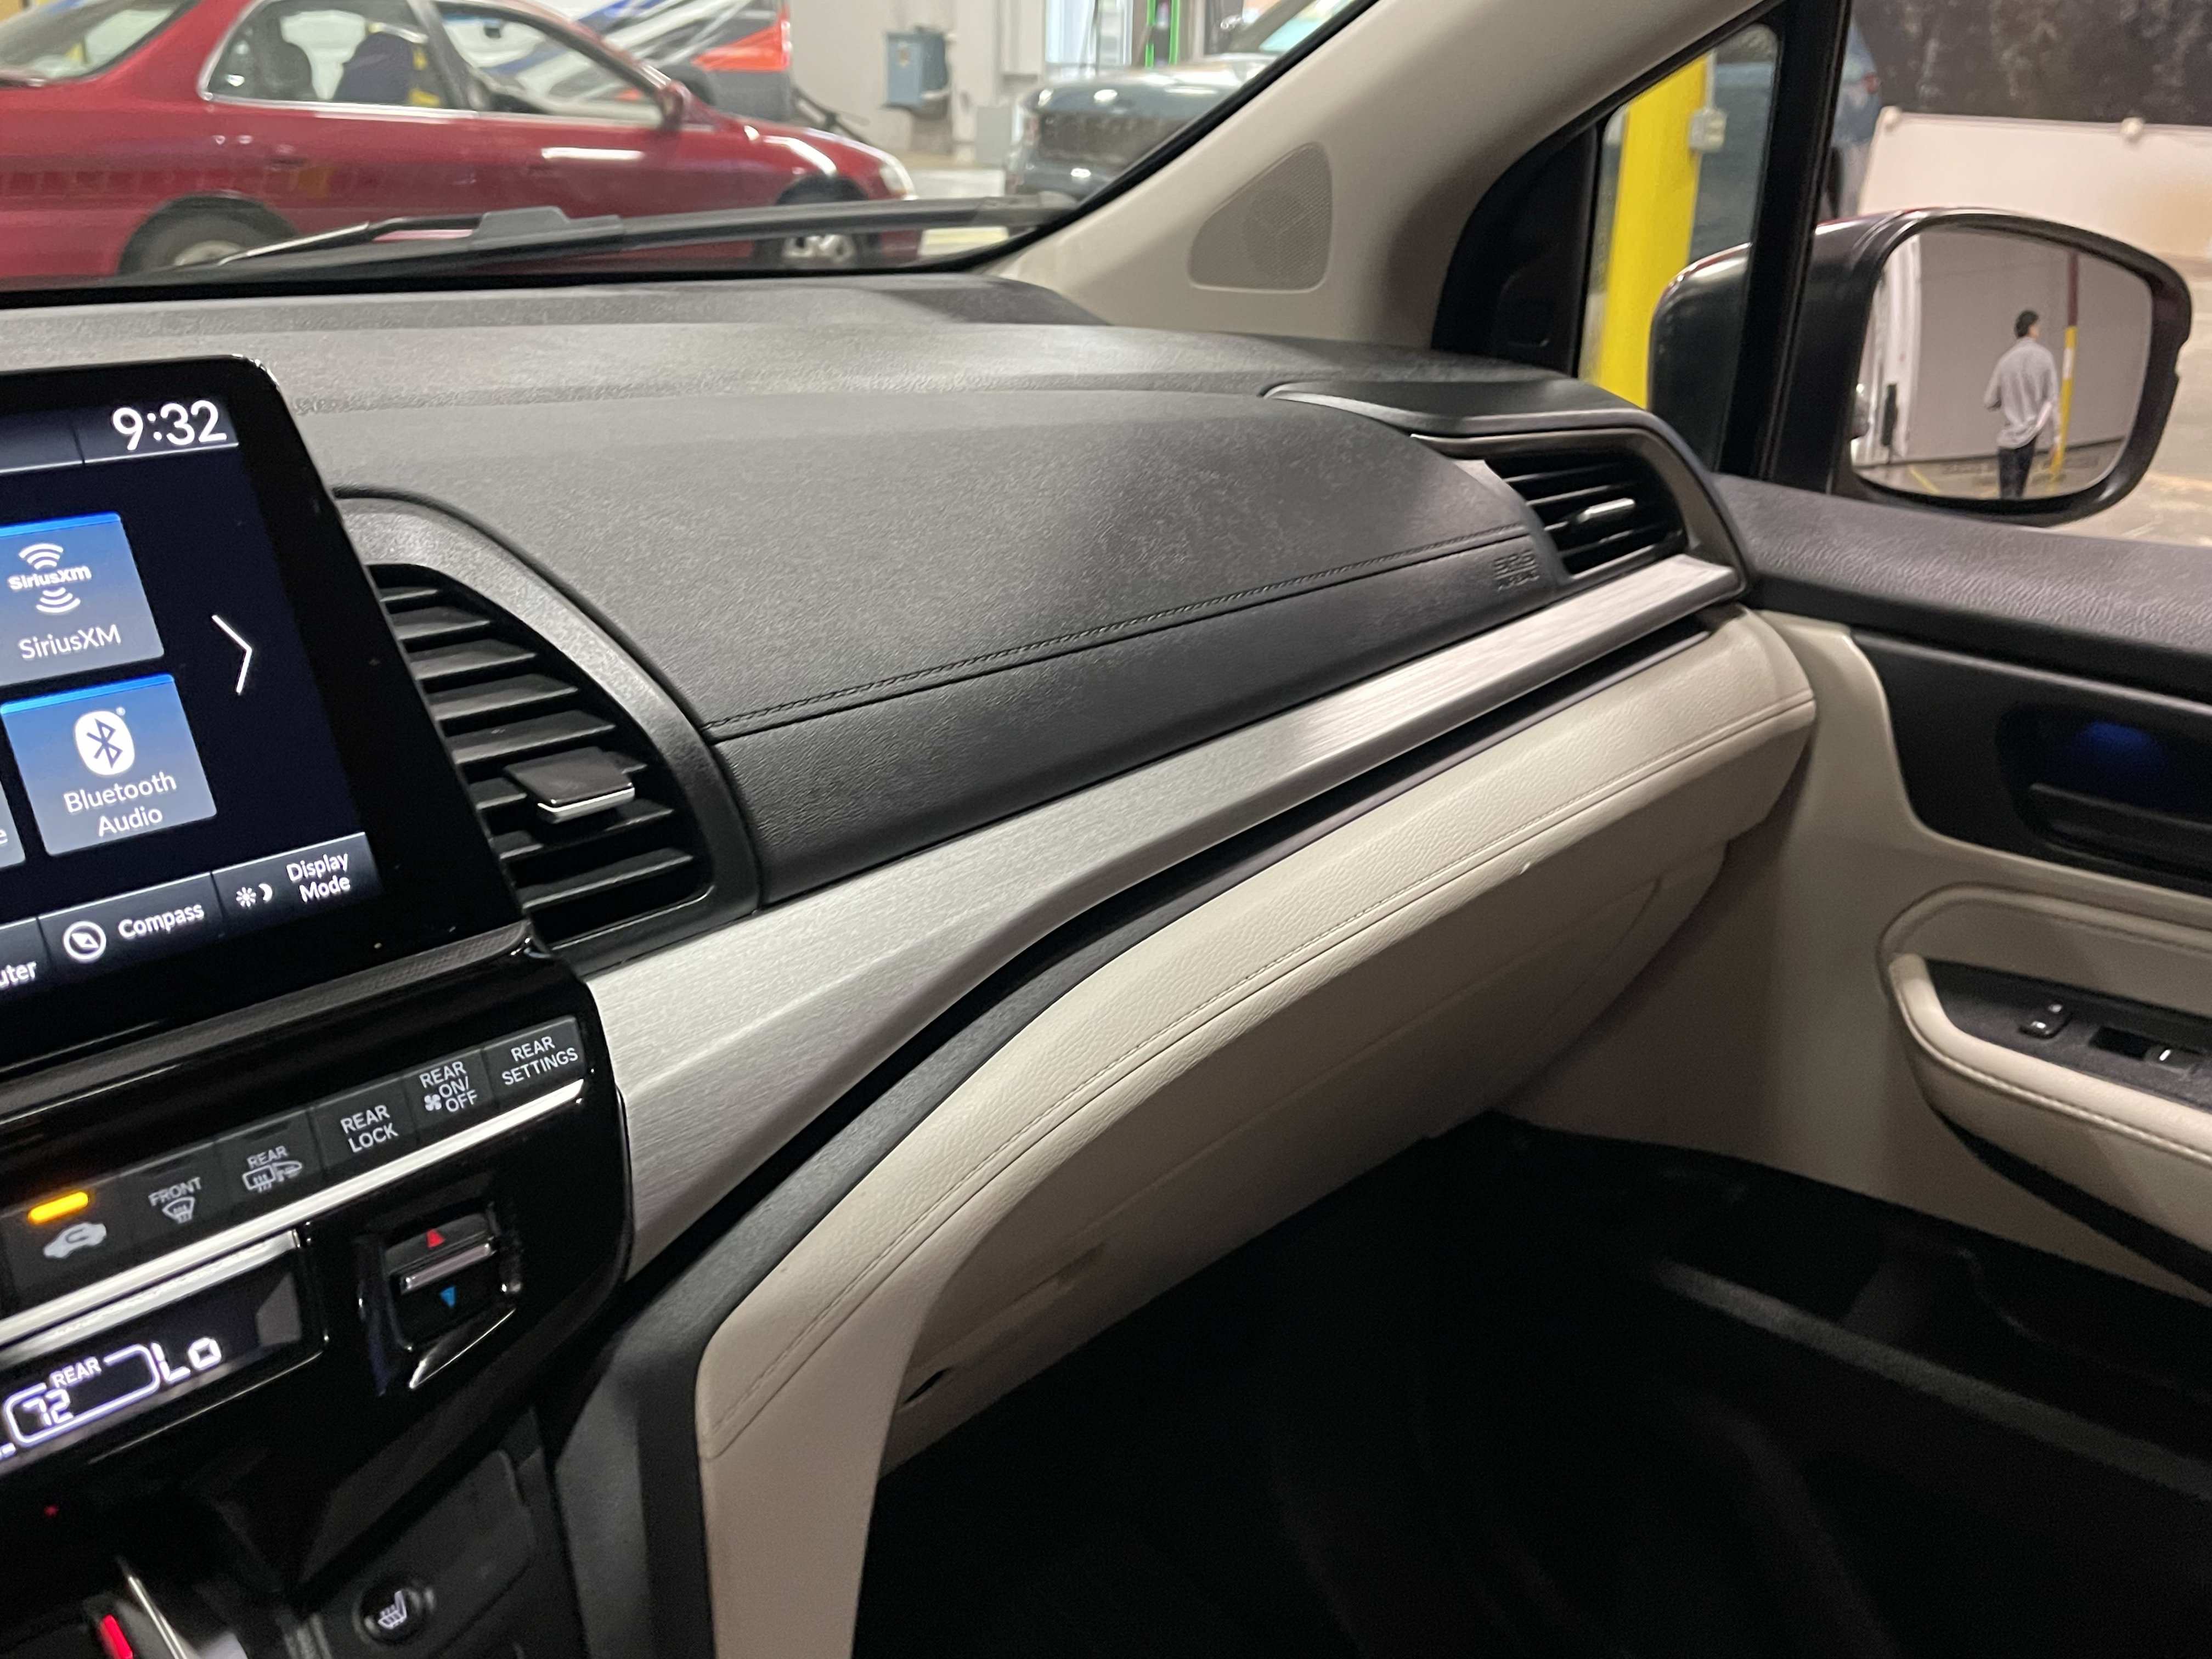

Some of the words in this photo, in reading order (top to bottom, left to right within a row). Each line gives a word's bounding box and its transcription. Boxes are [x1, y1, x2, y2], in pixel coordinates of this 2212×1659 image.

[112, 400, 227, 450] 9:32
[19, 624, 121, 659] SiriusXM
[64, 772, 177, 814] Bluetooth
[98, 806, 163, 837] Audio
[286, 852, 349, 883] Display
[300, 875, 351, 903] Mode
[118, 902, 205, 939] Compass
[511, 1036, 555, 1061] REAR
[420, 1062, 466, 1088] REAR
[501, 1047, 578, 1086] SETTINGS
[445, 1090, 477, 1112] OFF
[341, 1105, 390, 1134] REAR
[348, 1122, 398, 1153] LOCK
[246, 1146, 288, 1168] REAR
[148, 1177, 201, 1206] FRONT
[49, 1357, 102, 1389] REAR
[22, 1389, 74, 1426] 72
